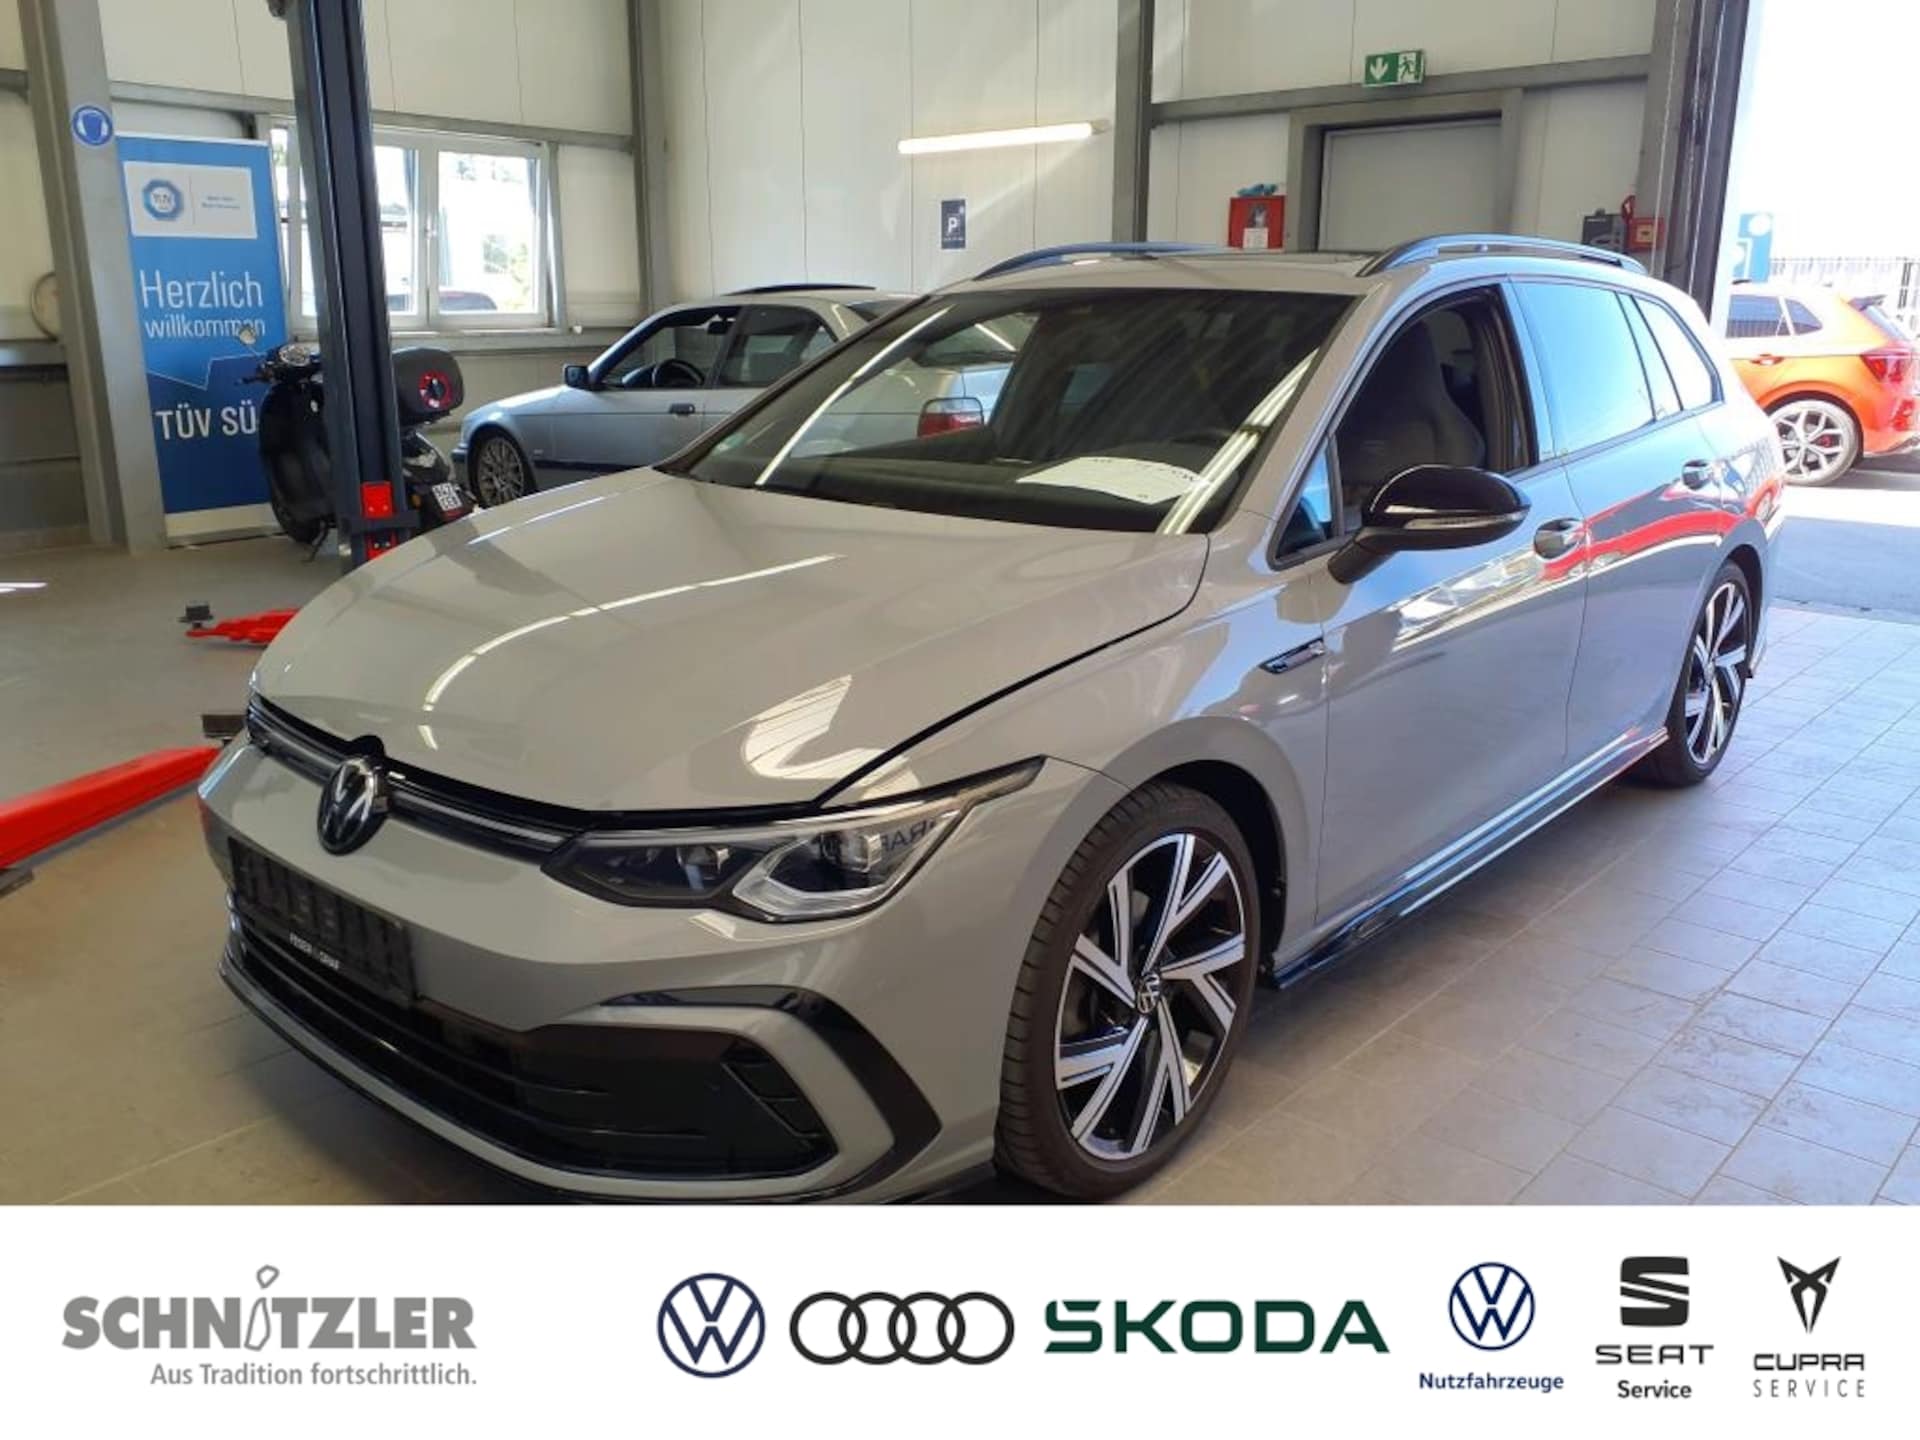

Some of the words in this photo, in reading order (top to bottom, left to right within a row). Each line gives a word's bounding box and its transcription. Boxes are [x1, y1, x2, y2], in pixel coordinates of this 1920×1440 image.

[948, 216, 958, 233] P
[139, 269, 264, 308] Herzlich
[154, 402, 211, 440] TÜV
[220, 399, 257, 436] SÜ
